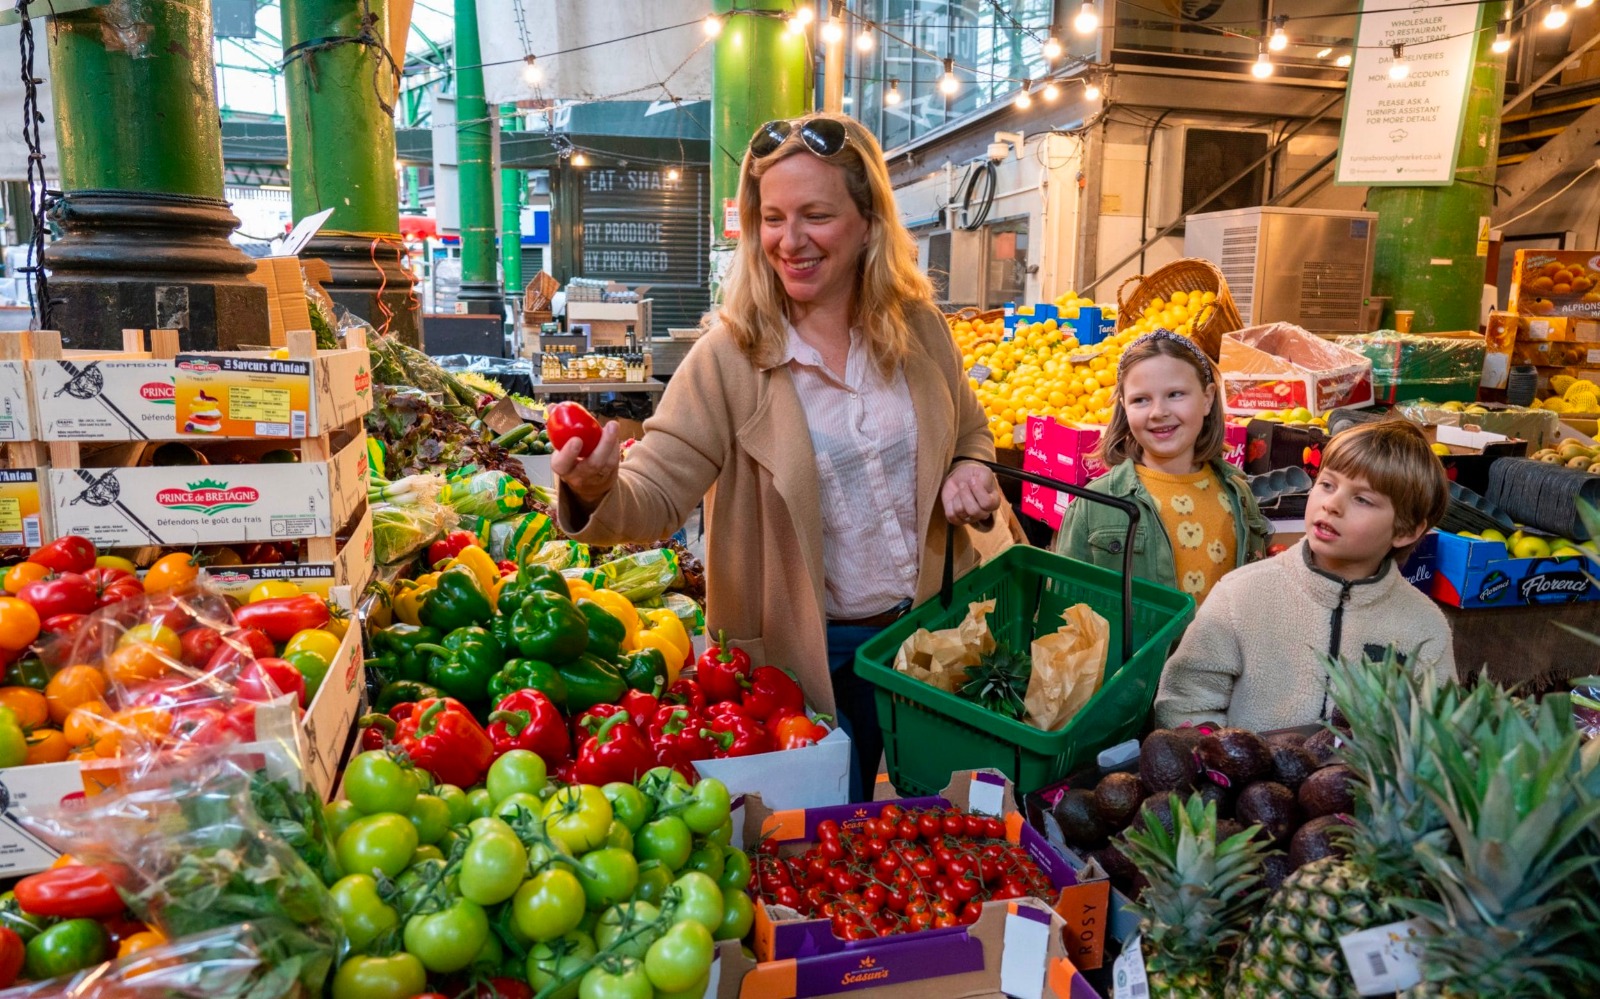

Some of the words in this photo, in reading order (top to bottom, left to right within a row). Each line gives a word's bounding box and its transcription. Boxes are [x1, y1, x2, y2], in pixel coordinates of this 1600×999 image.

[1391, 17, 1443, 27] WHOLESALER
[1397, 25, 1448, 36] RESTAURANT
[1386, 36, 1424, 46] CATERING
[1403, 52, 1444, 62] DELIVERIES
[1407, 70, 1450, 79] ACCOUNTS
[1387, 81, 1427, 89] AVAILABLE
[1378, 99, 1405, 107] PLEASE
[1407, 98, 1422, 106] ASK
[1366, 108, 1397, 116] TURNIPS
[1399, 105, 1441, 115] ASSISTANT
[1366, 117, 1381, 125] FOR
[1383, 116, 1404, 124] MORE
[1406, 115, 1437, 123] DETAILS
[590, 170, 616, 192] EAT
[605, 222, 664, 244] PRODUCE
[603, 250, 669, 272] PREPARED
[233, 359, 268, 372] Saveurs
[141, 413, 176, 421] Défendo
[159, 492, 194, 503] PRINCE
[195, 493, 205, 502] de
[205, 491, 257, 502] BRETAGNE
[157, 518, 199, 526] Défendons
[201, 517, 209, 525] le
[211, 516, 230, 527] goût
[232, 516, 242, 524] du
[244, 515, 262, 524] frais
[261, 567, 295, 578] Saveurs
[1521, 573, 1589, 598] Florenci
[1080, 904, 1096, 955] ROSY
